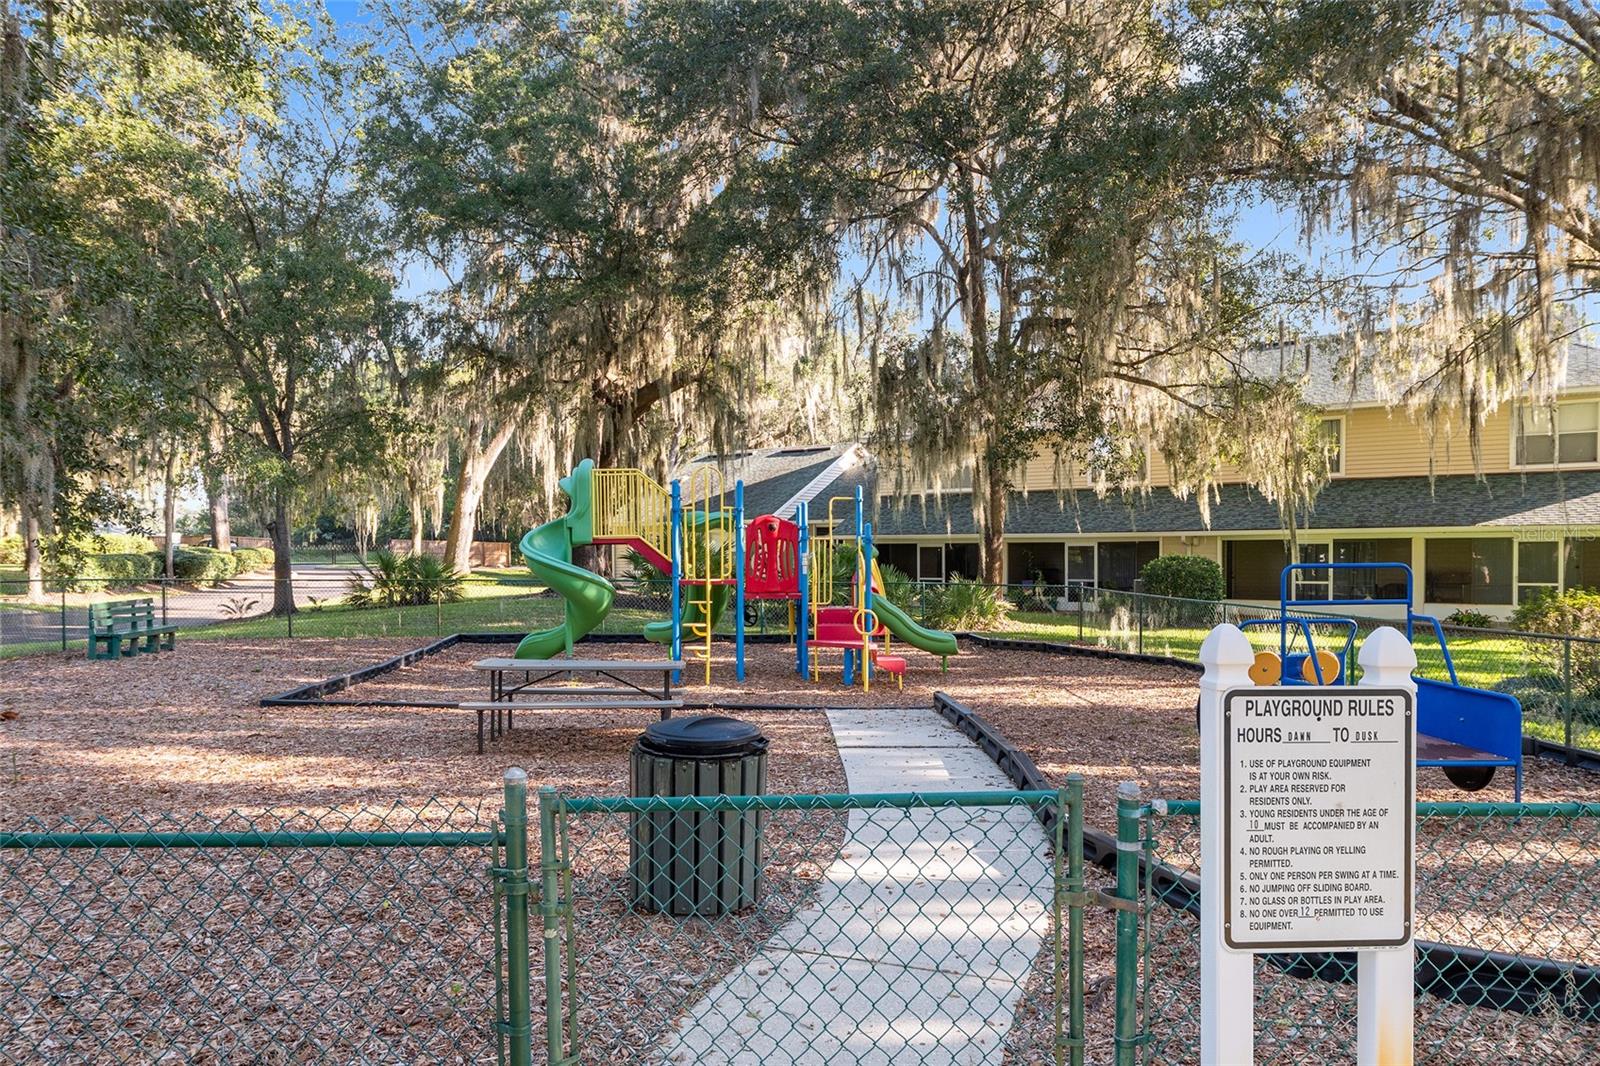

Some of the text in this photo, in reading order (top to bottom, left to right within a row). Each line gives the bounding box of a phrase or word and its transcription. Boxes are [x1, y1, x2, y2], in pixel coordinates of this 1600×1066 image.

[1246, 699, 1394, 717] PLAYGROUND RULES
[1237, 727, 1379, 743] HOURS DAWN TO DUSK
[1240, 759, 1371, 768] 1. USE OF PLAYGROUND EQUIPMENT
[1249, 772, 1332, 780] IS AT YOUR OWN RISK.
[1240, 784, 1346, 793] 2. PLAY AREA RESERVED FOR
[1250, 797, 1312, 805] RESIDENTS ONLY.
[1240, 808, 1389, 818] 3. YOUNG RESIDENTS UNDER THE AGE OF
[1249, 819, 1379, 830] 10 MUST BE ACCOMPANIED BY AN
[1249, 835, 1274, 843] ADULT.
[1240, 846, 1366, 856] 4. NO ROUGH PLAYING OR YELLING
[1250, 859, 1293, 867] PERMITTED.
[1240, 871, 1399, 881] 5. ONLY ONE PERSON PER SWING AT A TIME.
[1240, 883, 1372, 893] 6. NO JUMPING OFF SLIDING BOARD.
[1240, 895, 1385, 906] 7. NO GLASS OR BOTTLES IN PLAY AREA.
[1240, 906, 1384, 918] 8. NO ONE OVER 12 PERMITTED TO USE
[1250, 922, 1293, 930] EQUIPMENT.
